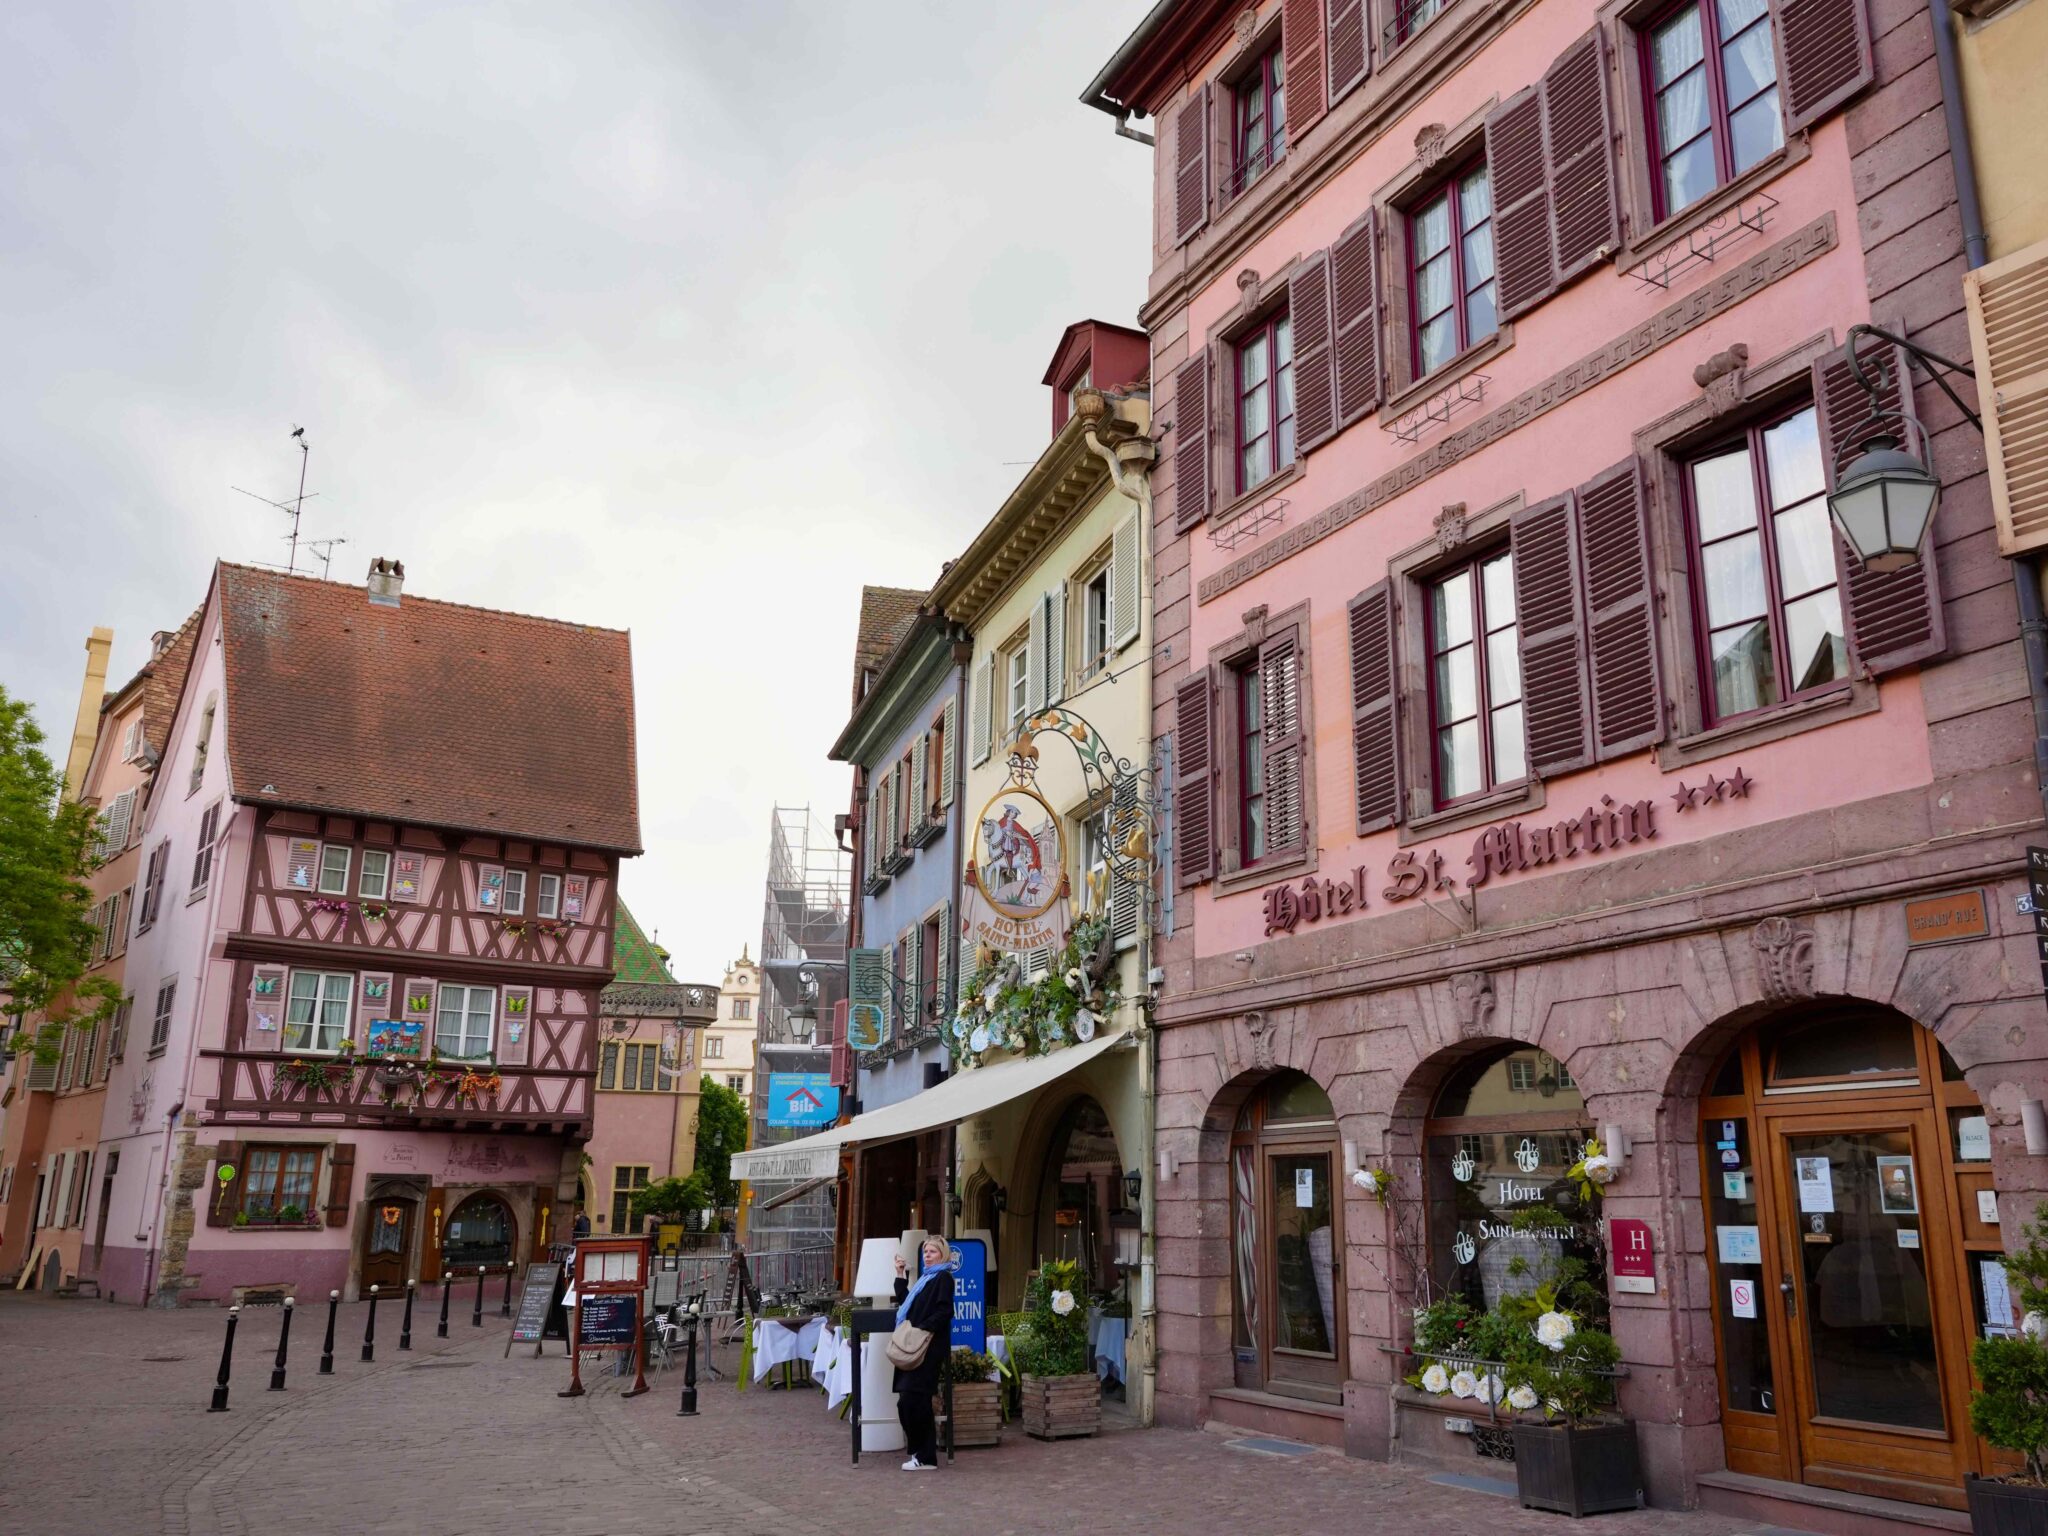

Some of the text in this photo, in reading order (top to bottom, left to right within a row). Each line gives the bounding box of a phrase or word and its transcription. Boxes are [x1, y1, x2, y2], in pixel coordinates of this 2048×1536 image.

[1262, 865, 1367, 937] Hôtel
[1465, 794, 1656, 889] Martin
[2018, 898, 2033, 912] 3
[1955, 908, 1979, 923] RUE
[992, 917, 1039, 935] HOTEL
[976, 921, 1055, 951] SAINT-MARTIN
[790, 1097, 814, 1113] Bilz
[1630, 1230, 1646, 1250] H
[954, 1278, 967, 1297] EL
[953, 1301, 982, 1320] ARTIN
[961, 1325, 972, 1333] 1361
